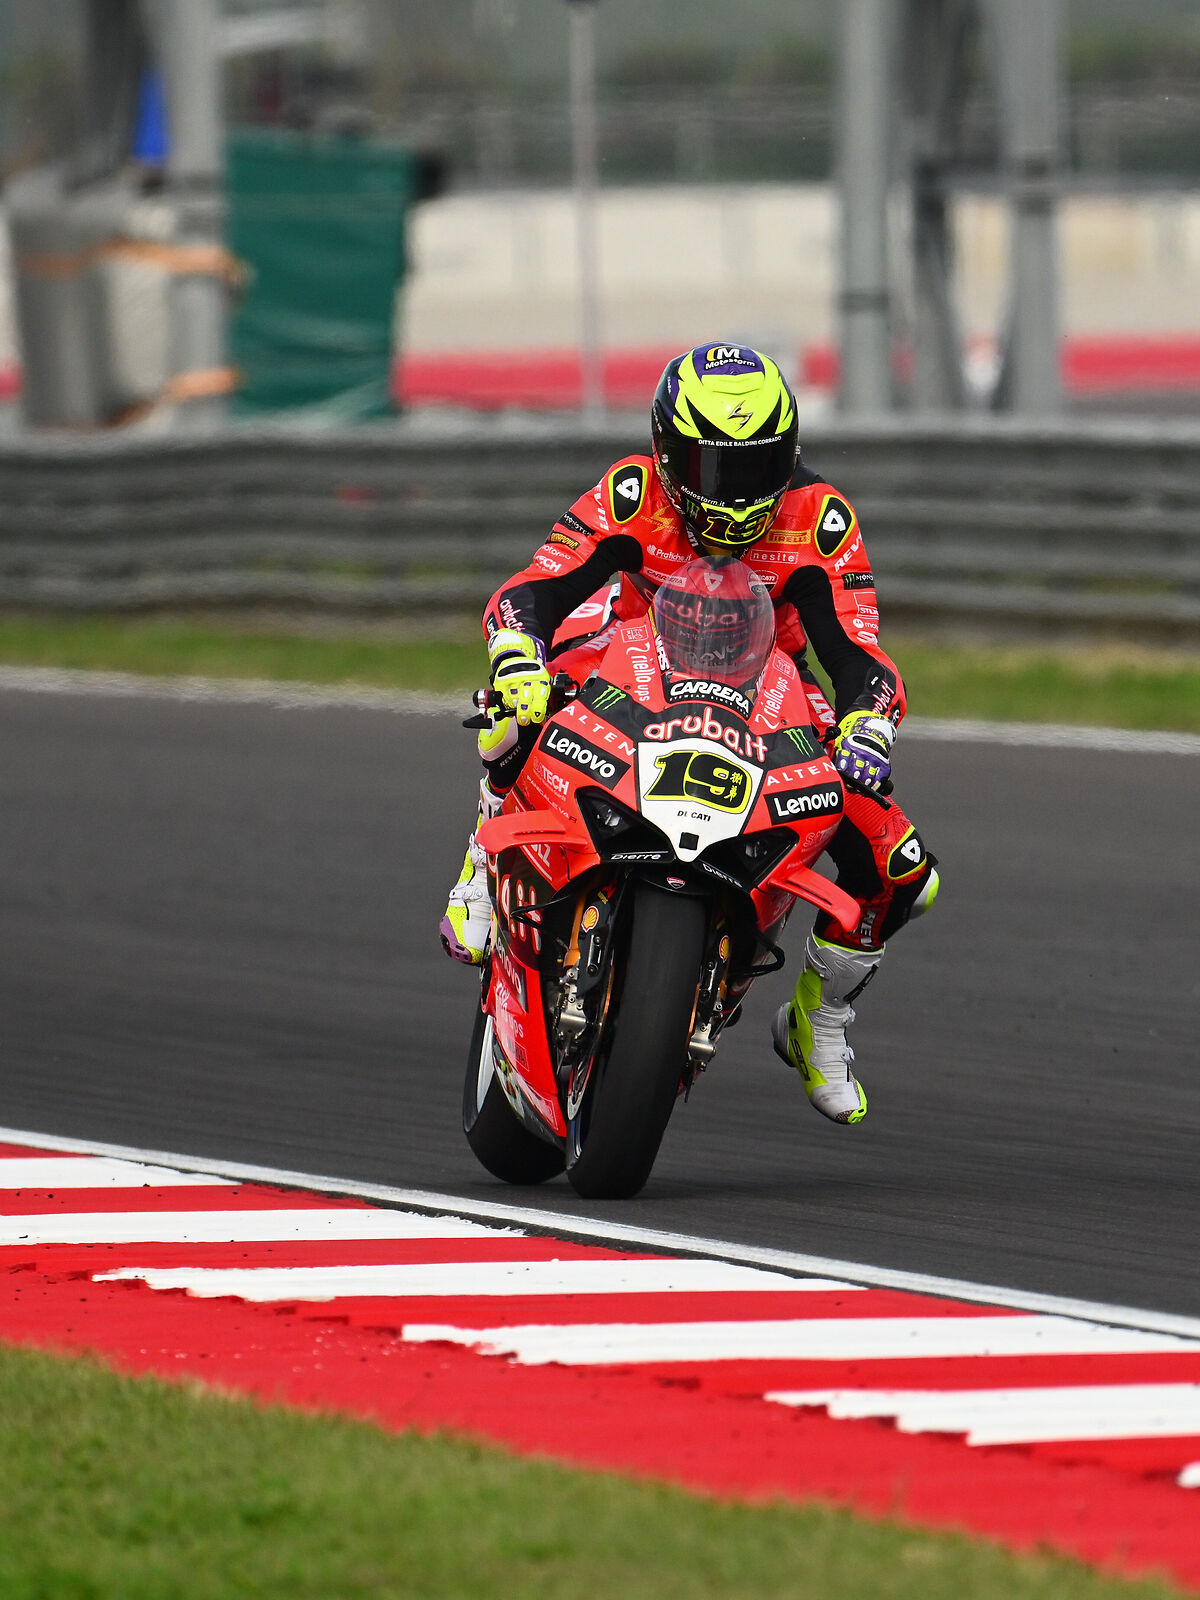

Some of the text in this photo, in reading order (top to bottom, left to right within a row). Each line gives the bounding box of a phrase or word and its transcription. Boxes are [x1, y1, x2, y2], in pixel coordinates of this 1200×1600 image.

[705, 358, 756, 370] Motostorm
[758, 435, 782, 445] CORRADO
[680, 485, 725, 507] Motostorm.it
[655, 634, 671, 671] WRS
[631, 655, 656, 683] riello
[634, 684, 651, 702] ups
[670, 681, 750, 714] CARRERA
[760, 688, 785, 719] riello
[562, 705, 637, 757] ALTEN
[644, 707, 768, 762] aruba.it
[546, 729, 616, 779] Lenovo
[644, 750, 752, 814] 19
[767, 761, 838, 787] ALTEN
[774, 791, 839, 817] Lenovo
